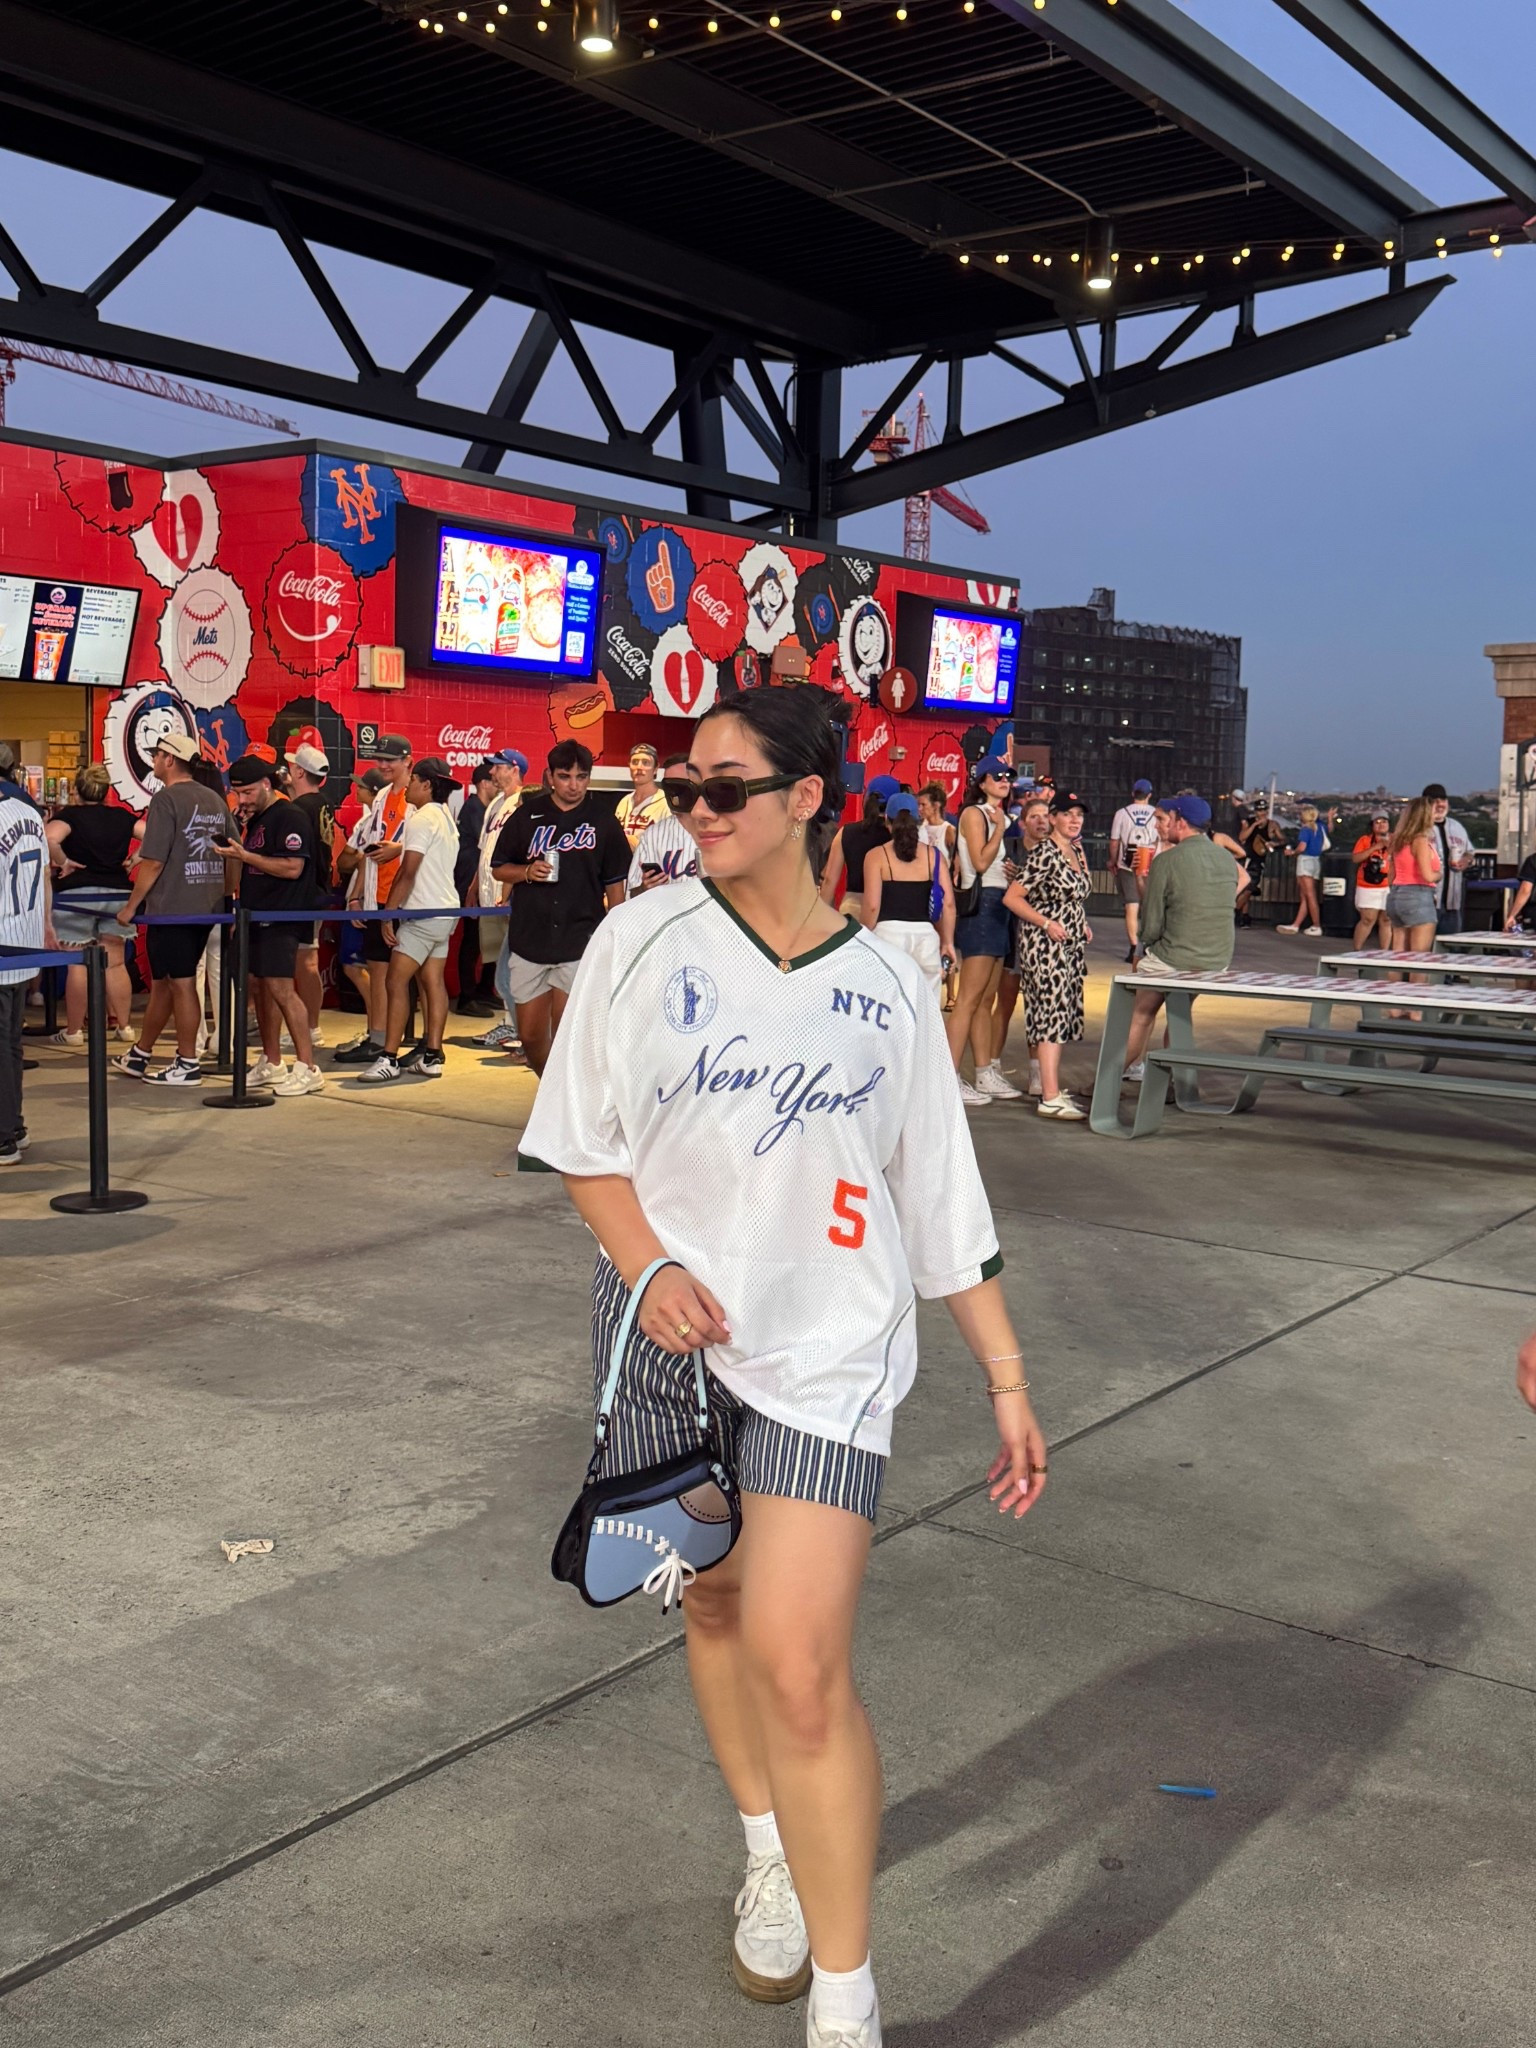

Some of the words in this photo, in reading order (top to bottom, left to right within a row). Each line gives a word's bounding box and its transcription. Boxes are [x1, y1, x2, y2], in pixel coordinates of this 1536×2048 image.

[279, 571, 345, 607] Coca-Cola
[692, 584, 733, 628] Coca-Cola
[193, 626, 218, 646] Mets
[606, 625, 650, 677] Coca-Cola
[379, 652, 401, 684] EXIT
[608, 647, 621, 664] ZERO
[620, 660, 636, 680] SUGAR
[438, 723, 494, 750] Coca-Cola
[860, 721, 889, 763] Coca-Cola
[446, 751, 496, 767] CORN
[927, 752, 960, 773] Coca-Cola
[527, 822, 597, 860] Mets
[9, 848, 42, 916] 17
[662, 848, 697, 880] Me
[832, 987, 891, 1031] NYC
[657, 1034, 770, 1104] New
[754, 1062, 886, 1157] York
[828, 1178, 868, 1250] 5
